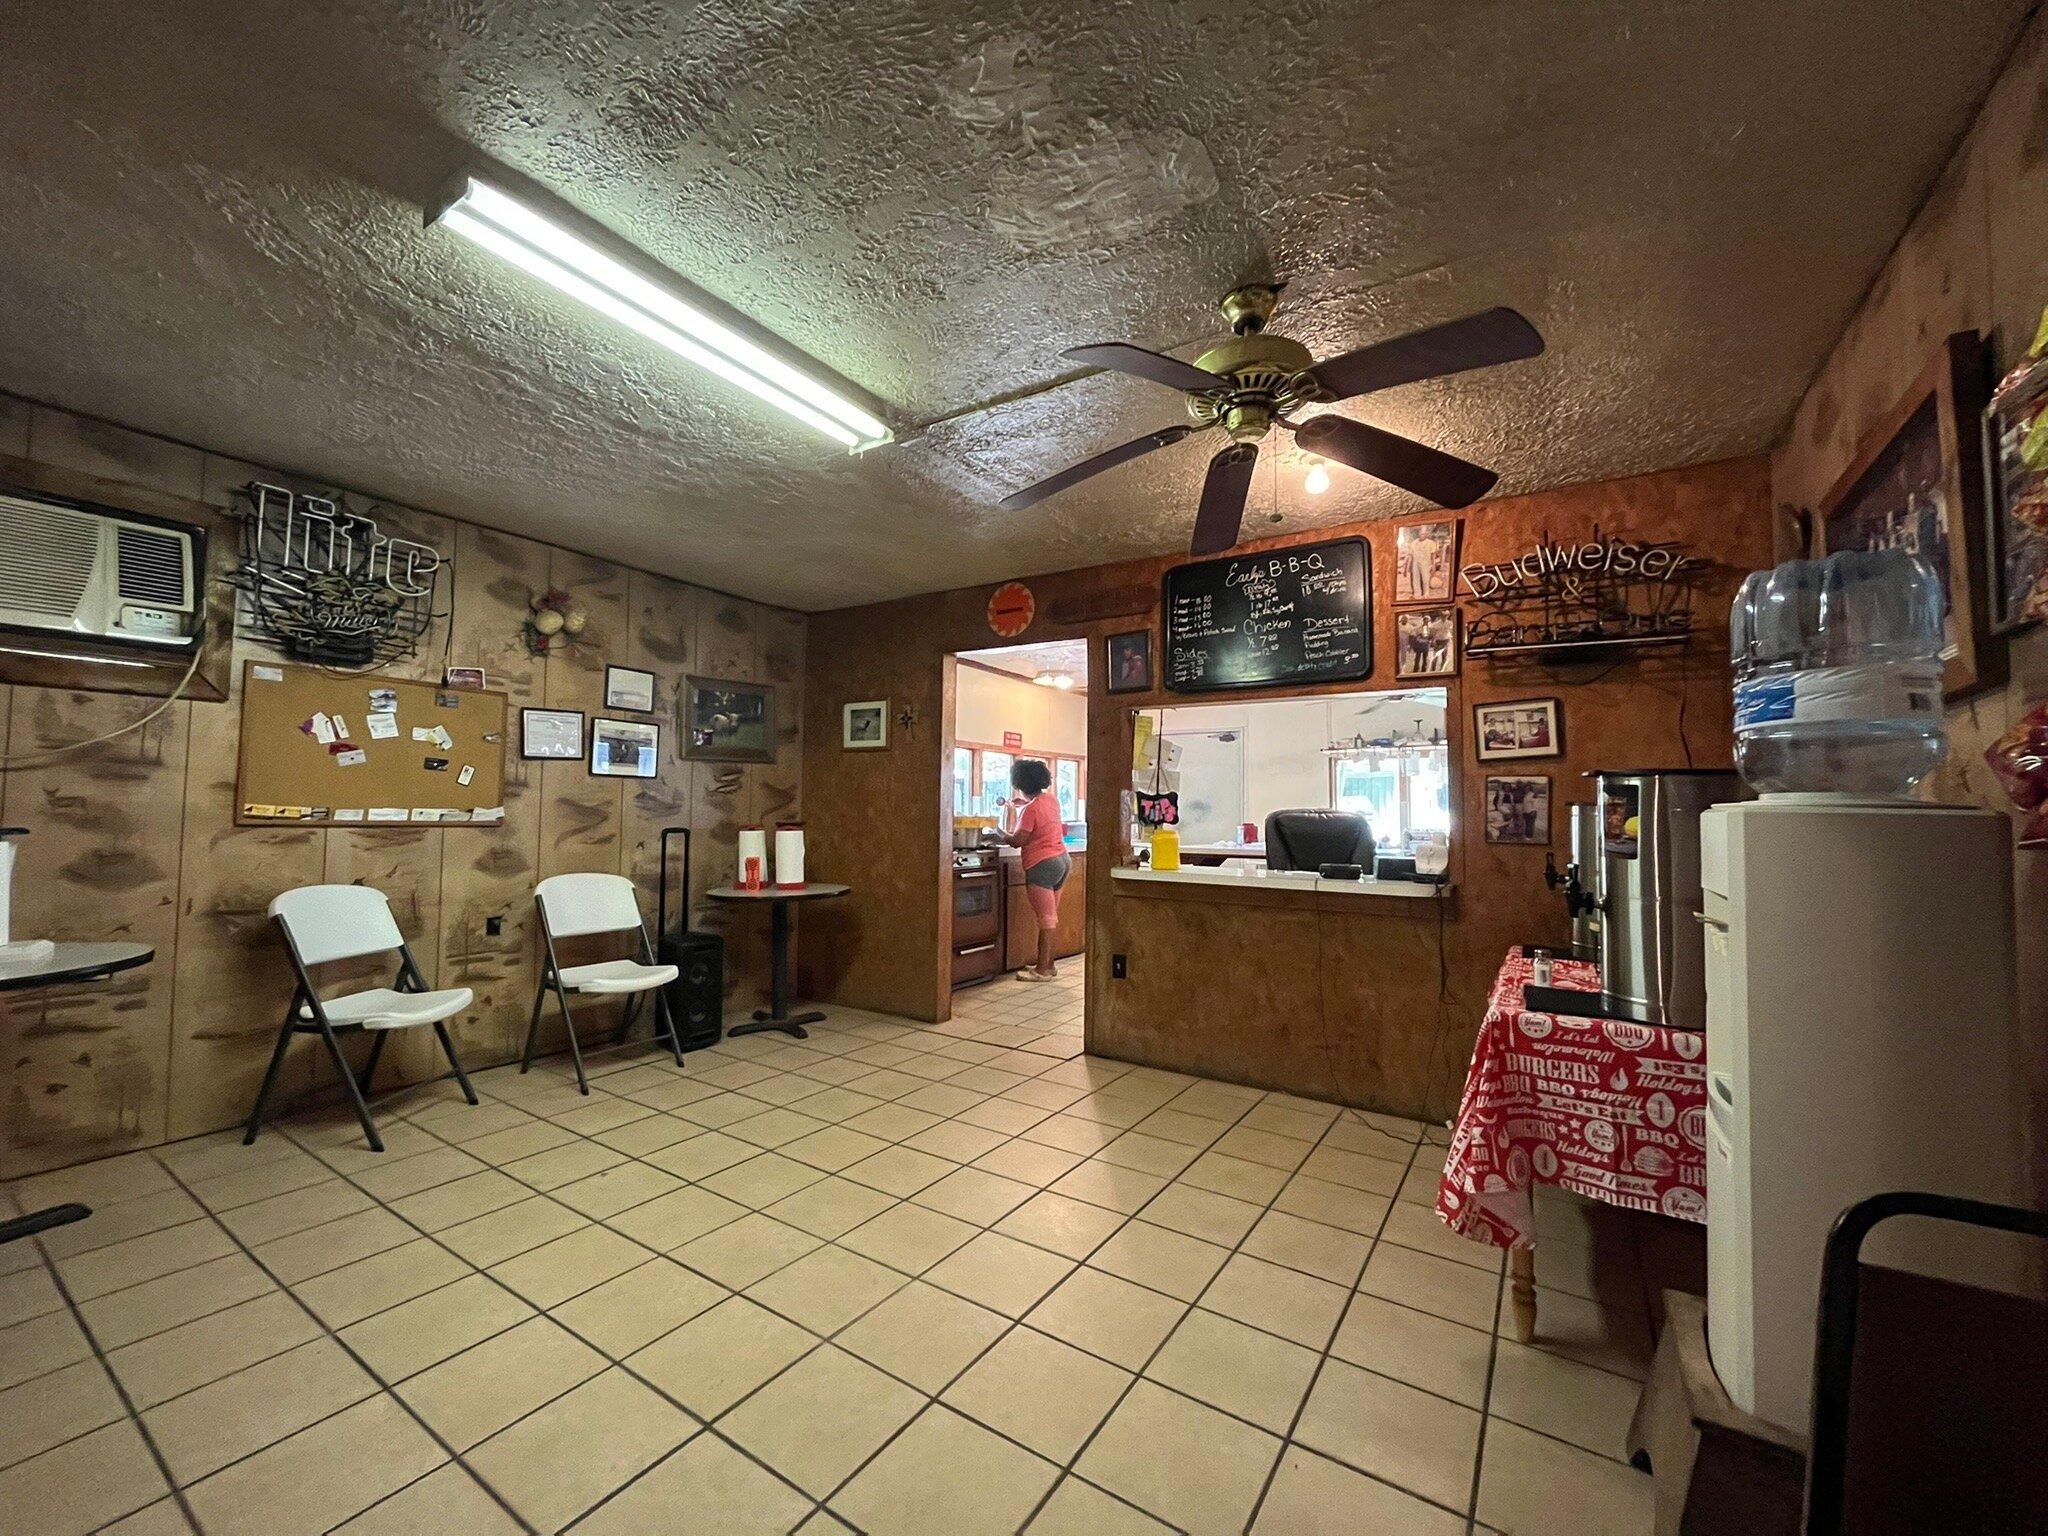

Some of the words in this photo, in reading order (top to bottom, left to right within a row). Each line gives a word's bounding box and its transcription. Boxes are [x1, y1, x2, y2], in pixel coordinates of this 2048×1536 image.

[1461, 543, 1697, 599] Budweiser
[1561, 576, 1584, 601] &
[1243, 619, 1292, 635] Chicken
[1303, 615, 1350, 631] Dessert
